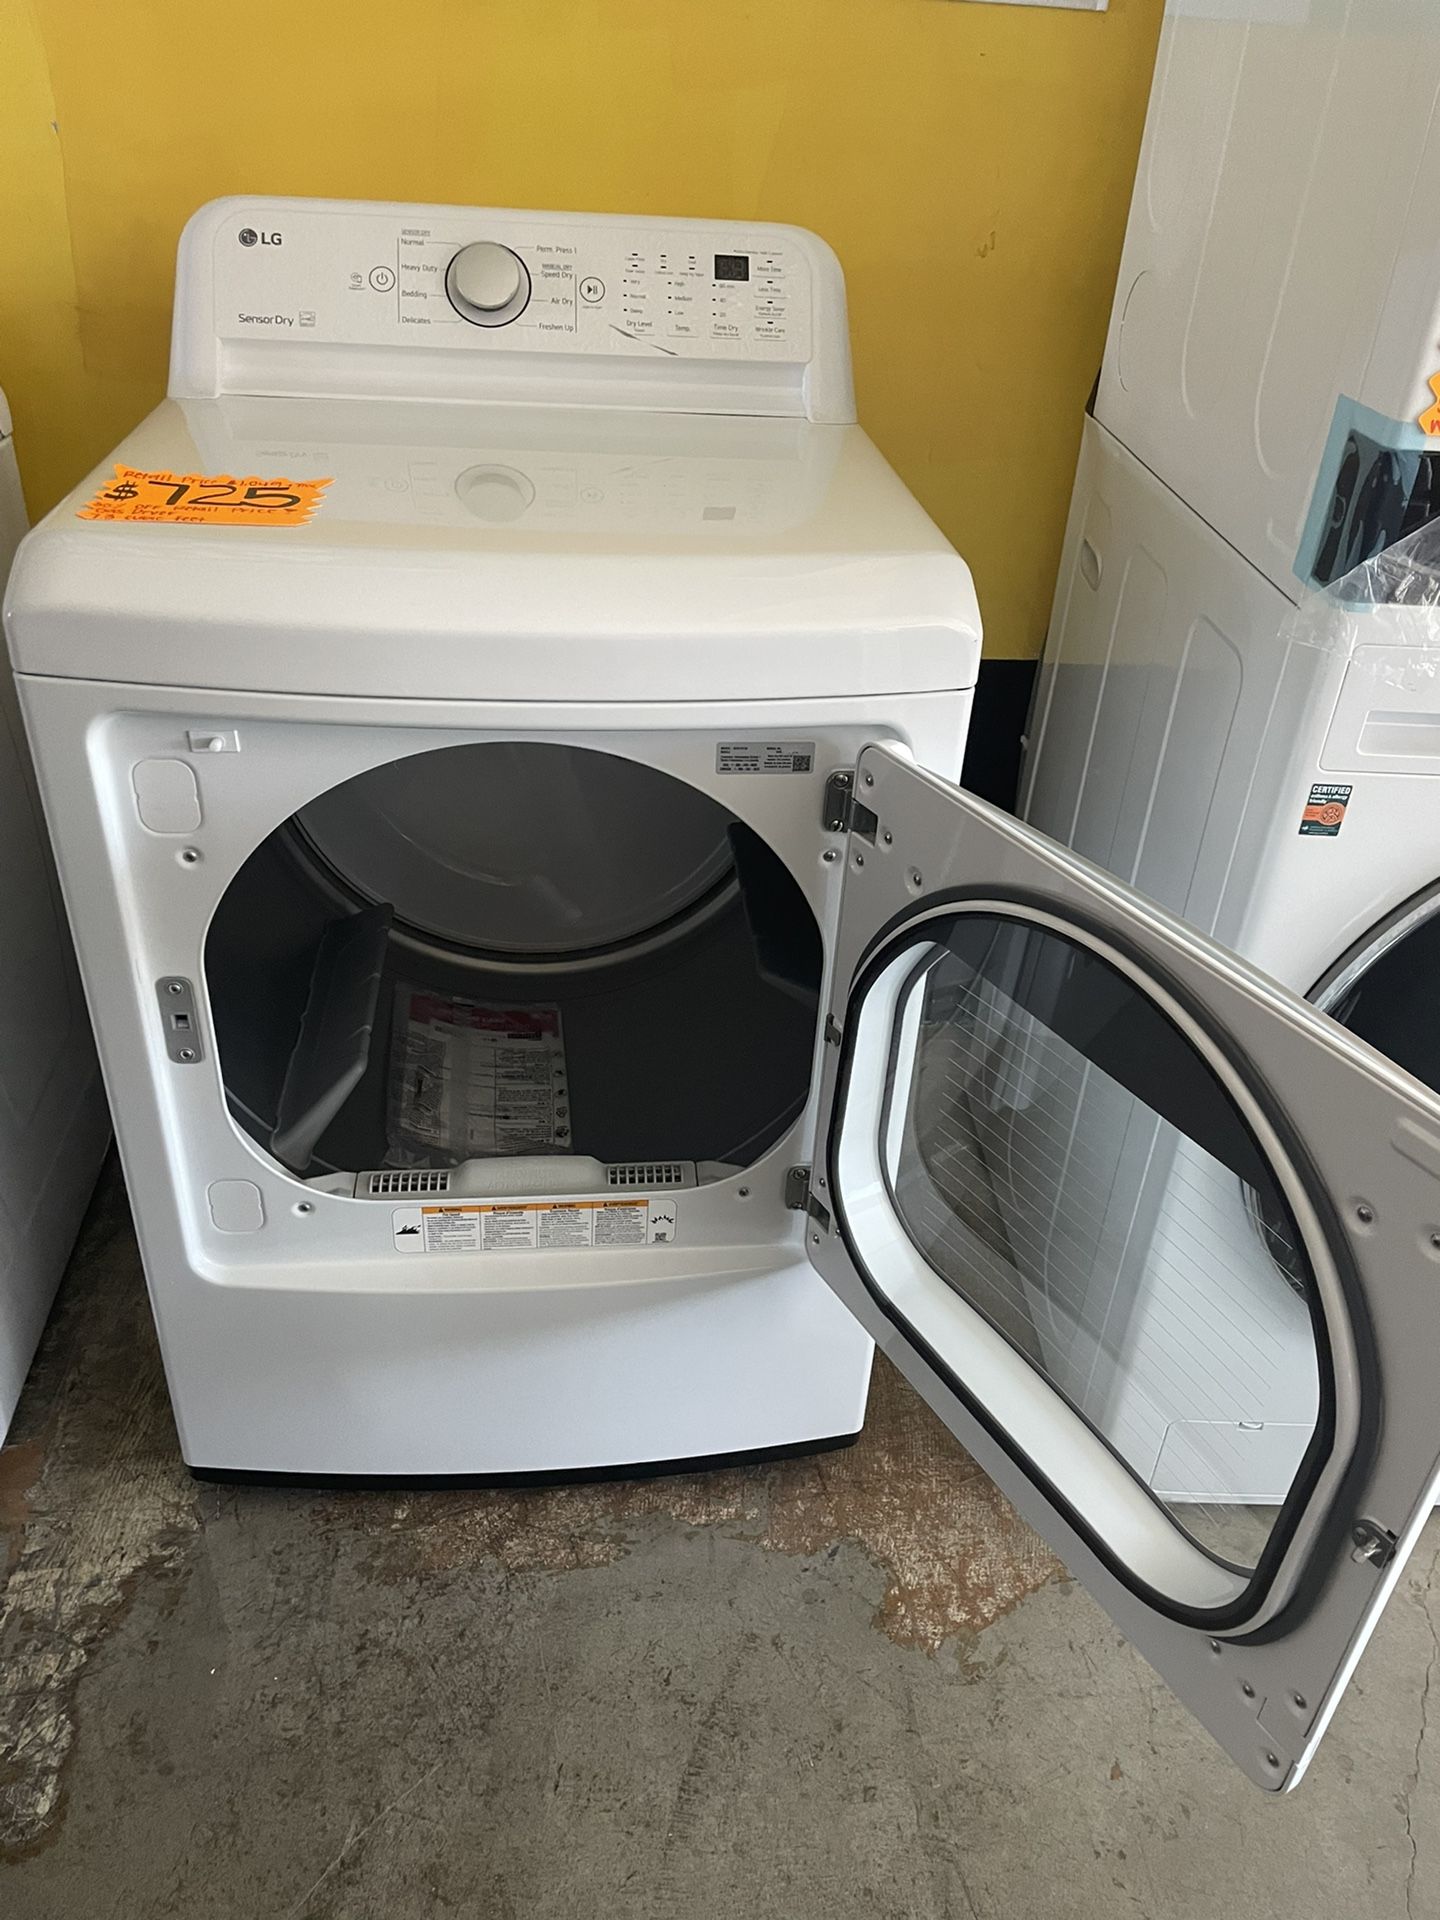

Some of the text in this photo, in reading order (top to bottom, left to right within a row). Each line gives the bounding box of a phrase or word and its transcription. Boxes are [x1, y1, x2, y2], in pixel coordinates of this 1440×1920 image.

[261, 232, 282, 246] LG
[401, 238, 425, 246] Normal
[555, 246, 573, 254] Press
[401, 264, 438, 272] Heavy Duty
[540, 270, 573, 280] Speed Dry
[401, 290, 428, 300] Bedding
[561, 297, 573, 307] Dry
[401, 316, 431, 325] Delicates
[626, 320, 637, 328] Dry
[538, 322, 574, 332] Freshen Up
[713, 323, 739, 333] Time Dry
[103, 480, 302, 510] $725
[1312, 785, 1351, 795] CERTIFIED
